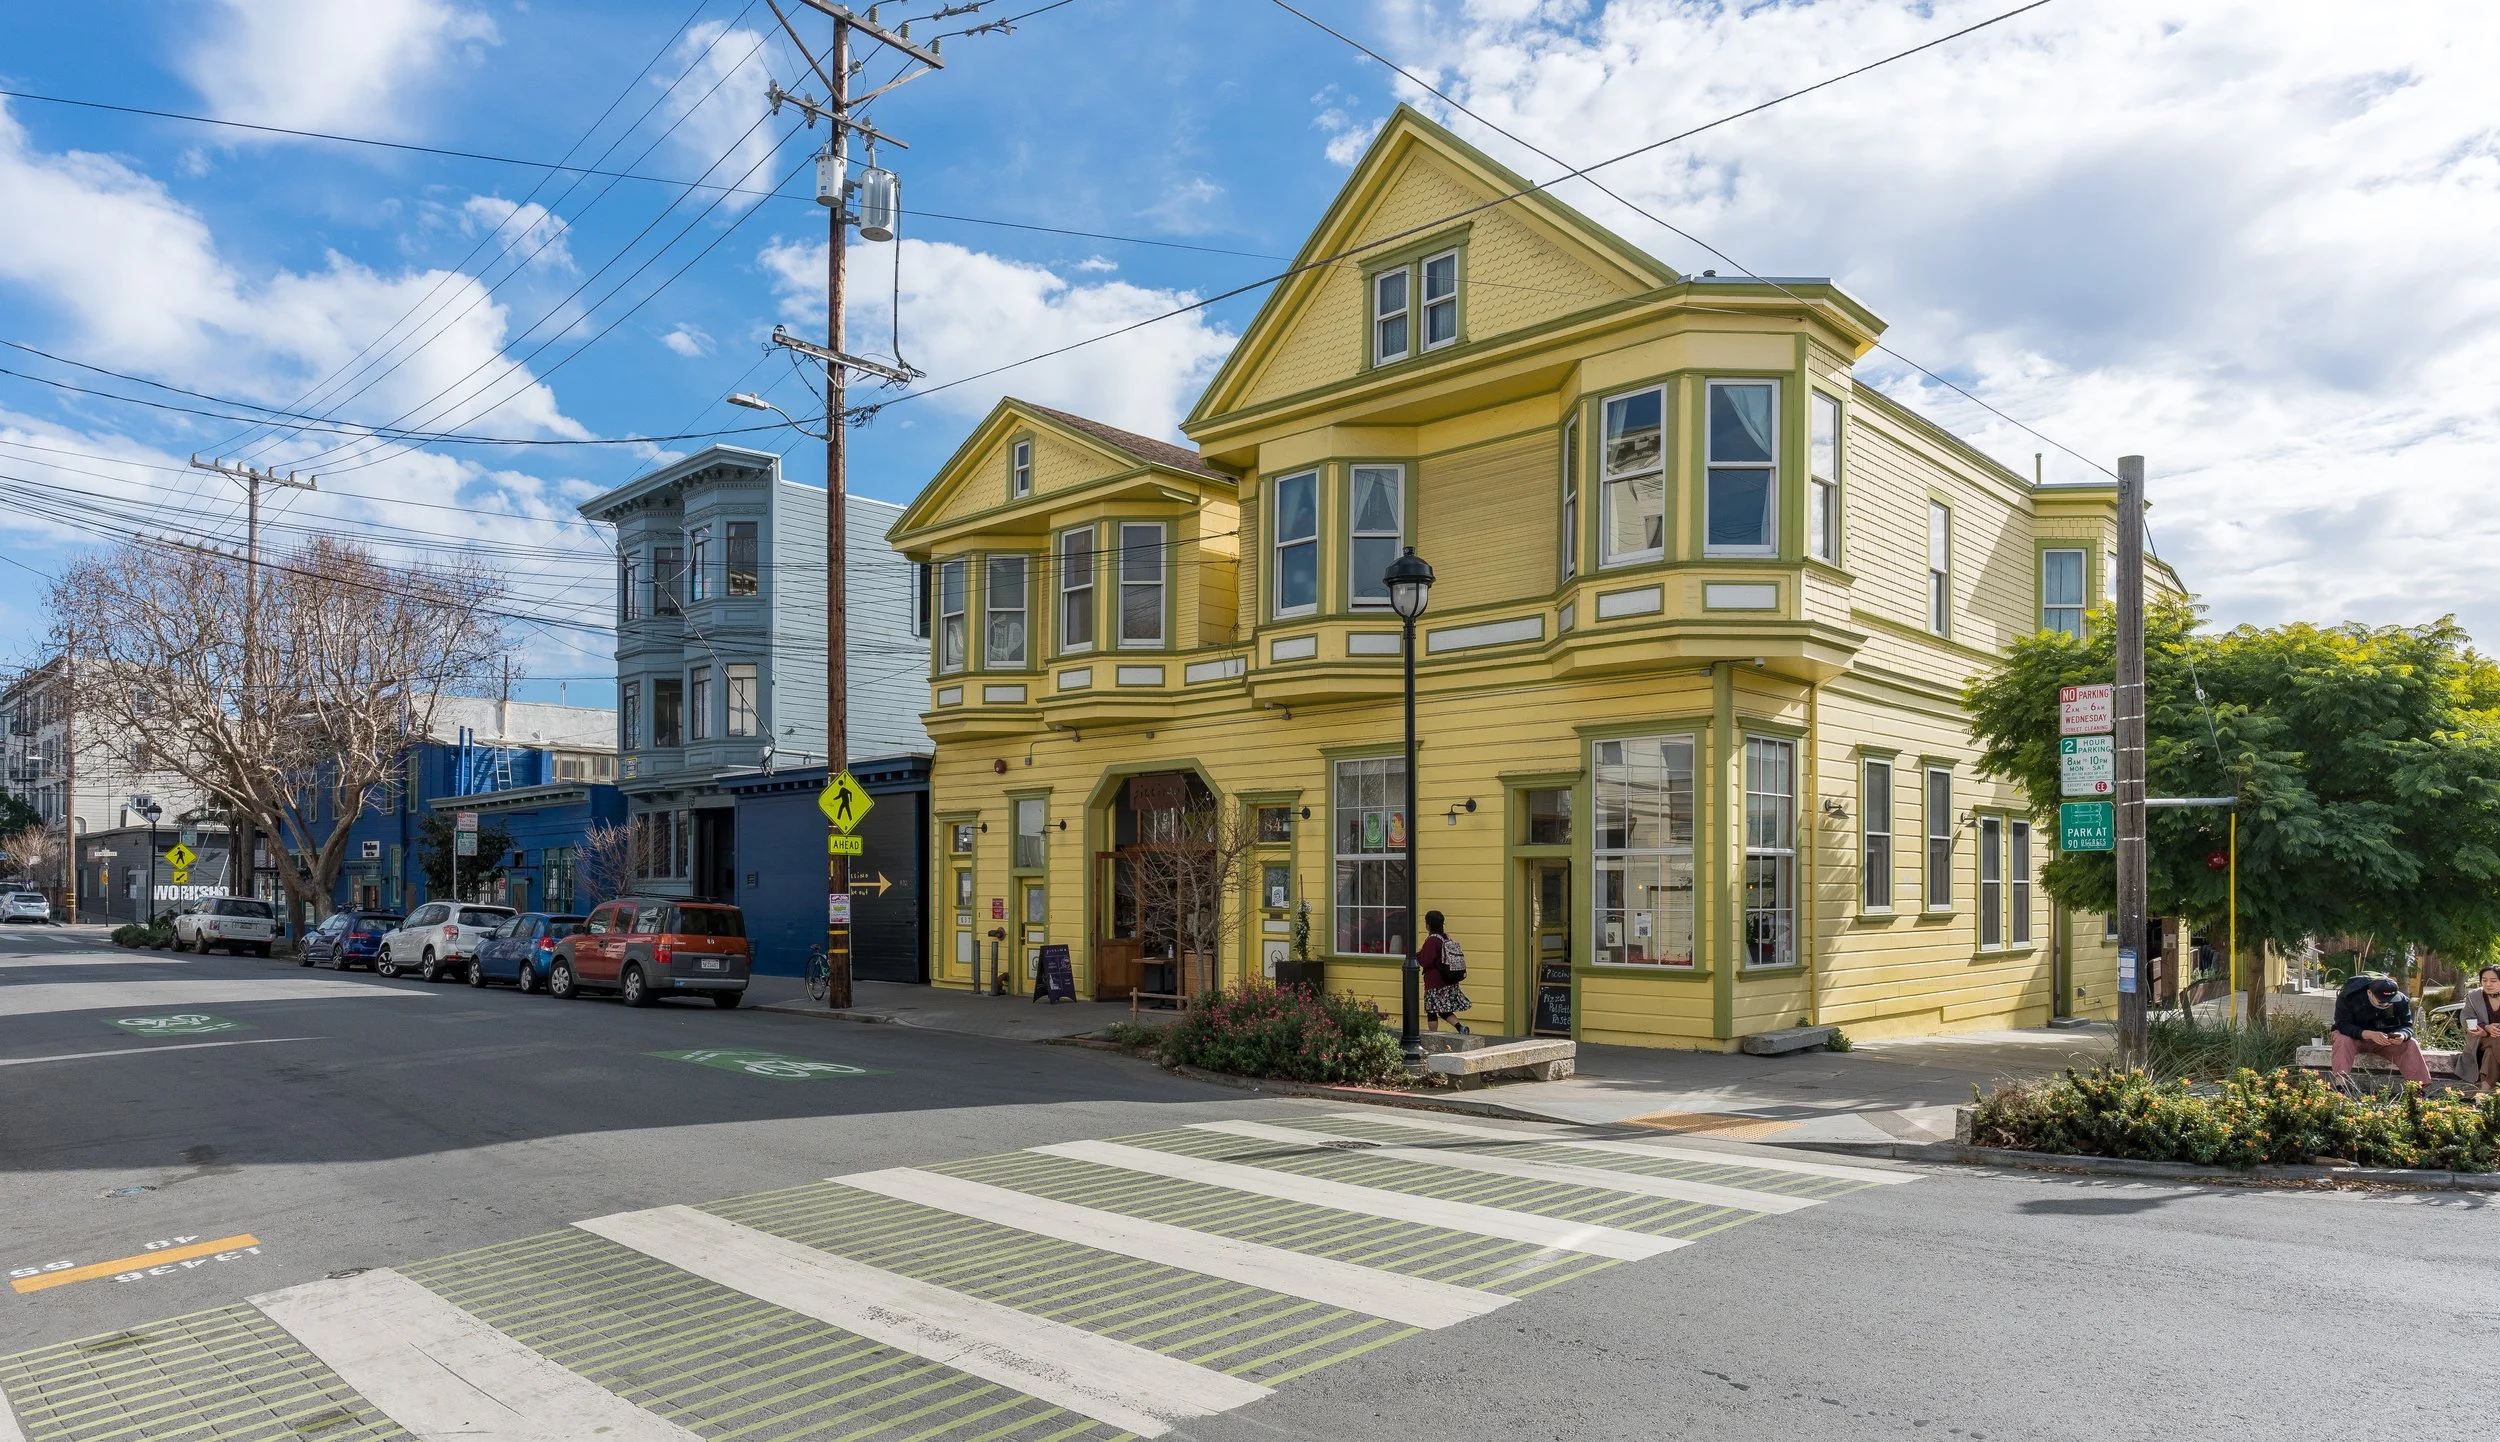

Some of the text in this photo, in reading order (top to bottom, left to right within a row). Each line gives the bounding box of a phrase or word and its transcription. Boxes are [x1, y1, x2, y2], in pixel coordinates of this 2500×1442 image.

[2062, 689, 2109, 702] NO PARKING
[2065, 714, 2107, 724] WEDNESDAY
[2065, 740, 2074, 752] 2
[2068, 827, 2107, 837] PARK AT
[833, 841, 860, 850] AHEAD
[2068, 839, 2078, 848] 90
[154, 885, 230, 900] WORKSHO
[1546, 969, 1570, 978] Piccin
[1544, 994, 1566, 1003] Pizza
